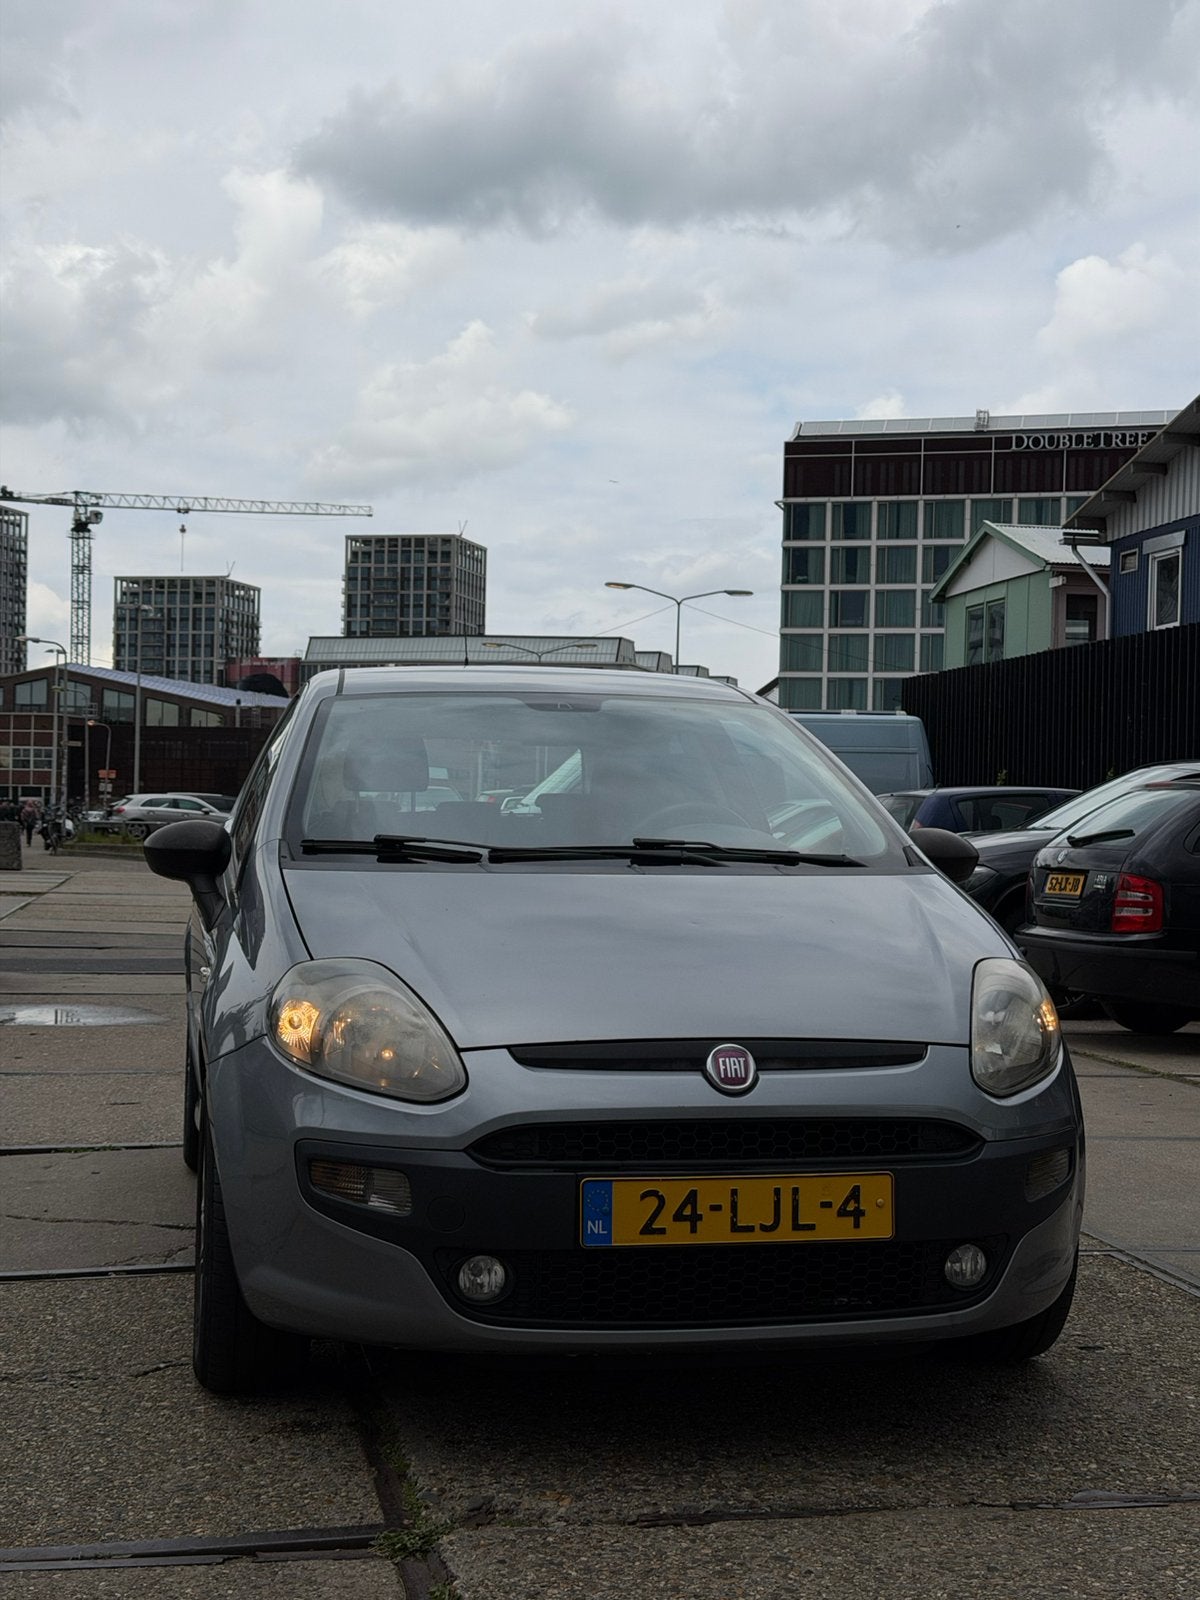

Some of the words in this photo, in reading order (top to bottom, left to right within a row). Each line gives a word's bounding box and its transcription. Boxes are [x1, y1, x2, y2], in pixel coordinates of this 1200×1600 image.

[718, 1057, 746, 1078] FIAT
[638, 1184, 867, 1235] 24-LJL-4
[587, 1219, 608, 1235] NL
